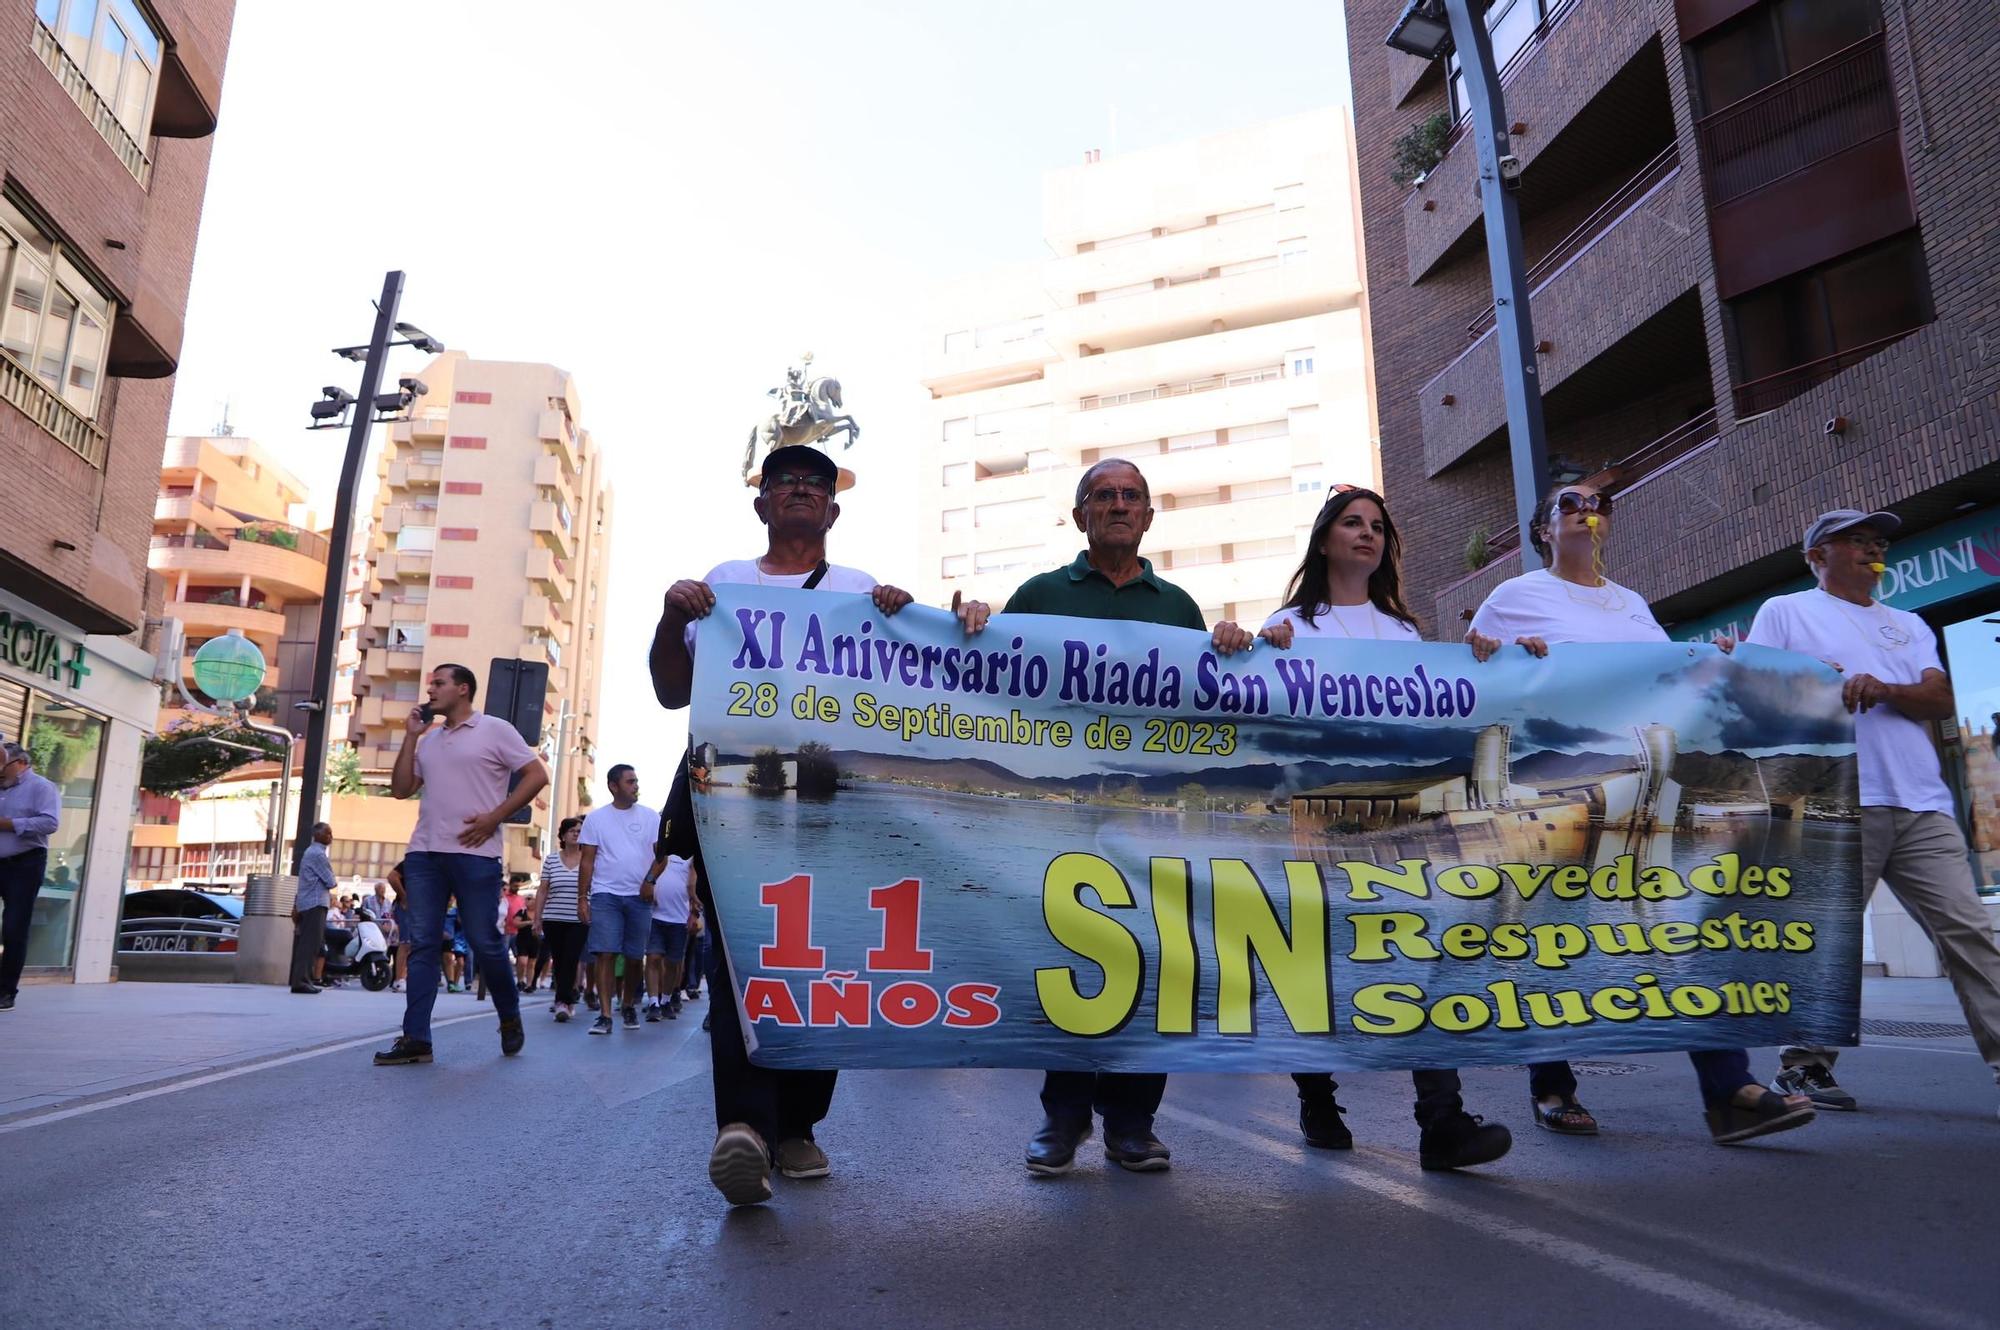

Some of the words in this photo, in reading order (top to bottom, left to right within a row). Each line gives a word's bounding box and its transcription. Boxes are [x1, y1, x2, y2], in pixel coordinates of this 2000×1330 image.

[1874, 536, 1979, 600] DRUNI
[732, 608, 785, 669] XI
[796, 613, 1049, 697] Aniversario
[1059, 639, 1182, 708] Riada
[1194, 651, 1269, 715] San
[1275, 658, 1476, 718] Wenceslao
[727, 681, 778, 718] 28
[791, 685, 840, 722] de
[853, 692, 1073, 748] Septiembre
[1084, 715, 1131, 751] de
[1143, 718, 1237, 756] 2023
[1336, 853, 1792, 901] Novedades
[133, 935, 187, 951] POLICÍA
[1034, 852, 1335, 1038] SIN
[1346, 911, 1816, 968] Respuestas
[743, 970, 1001, 1028] AÑOS
[1351, 973, 1792, 1034] Soluciones
